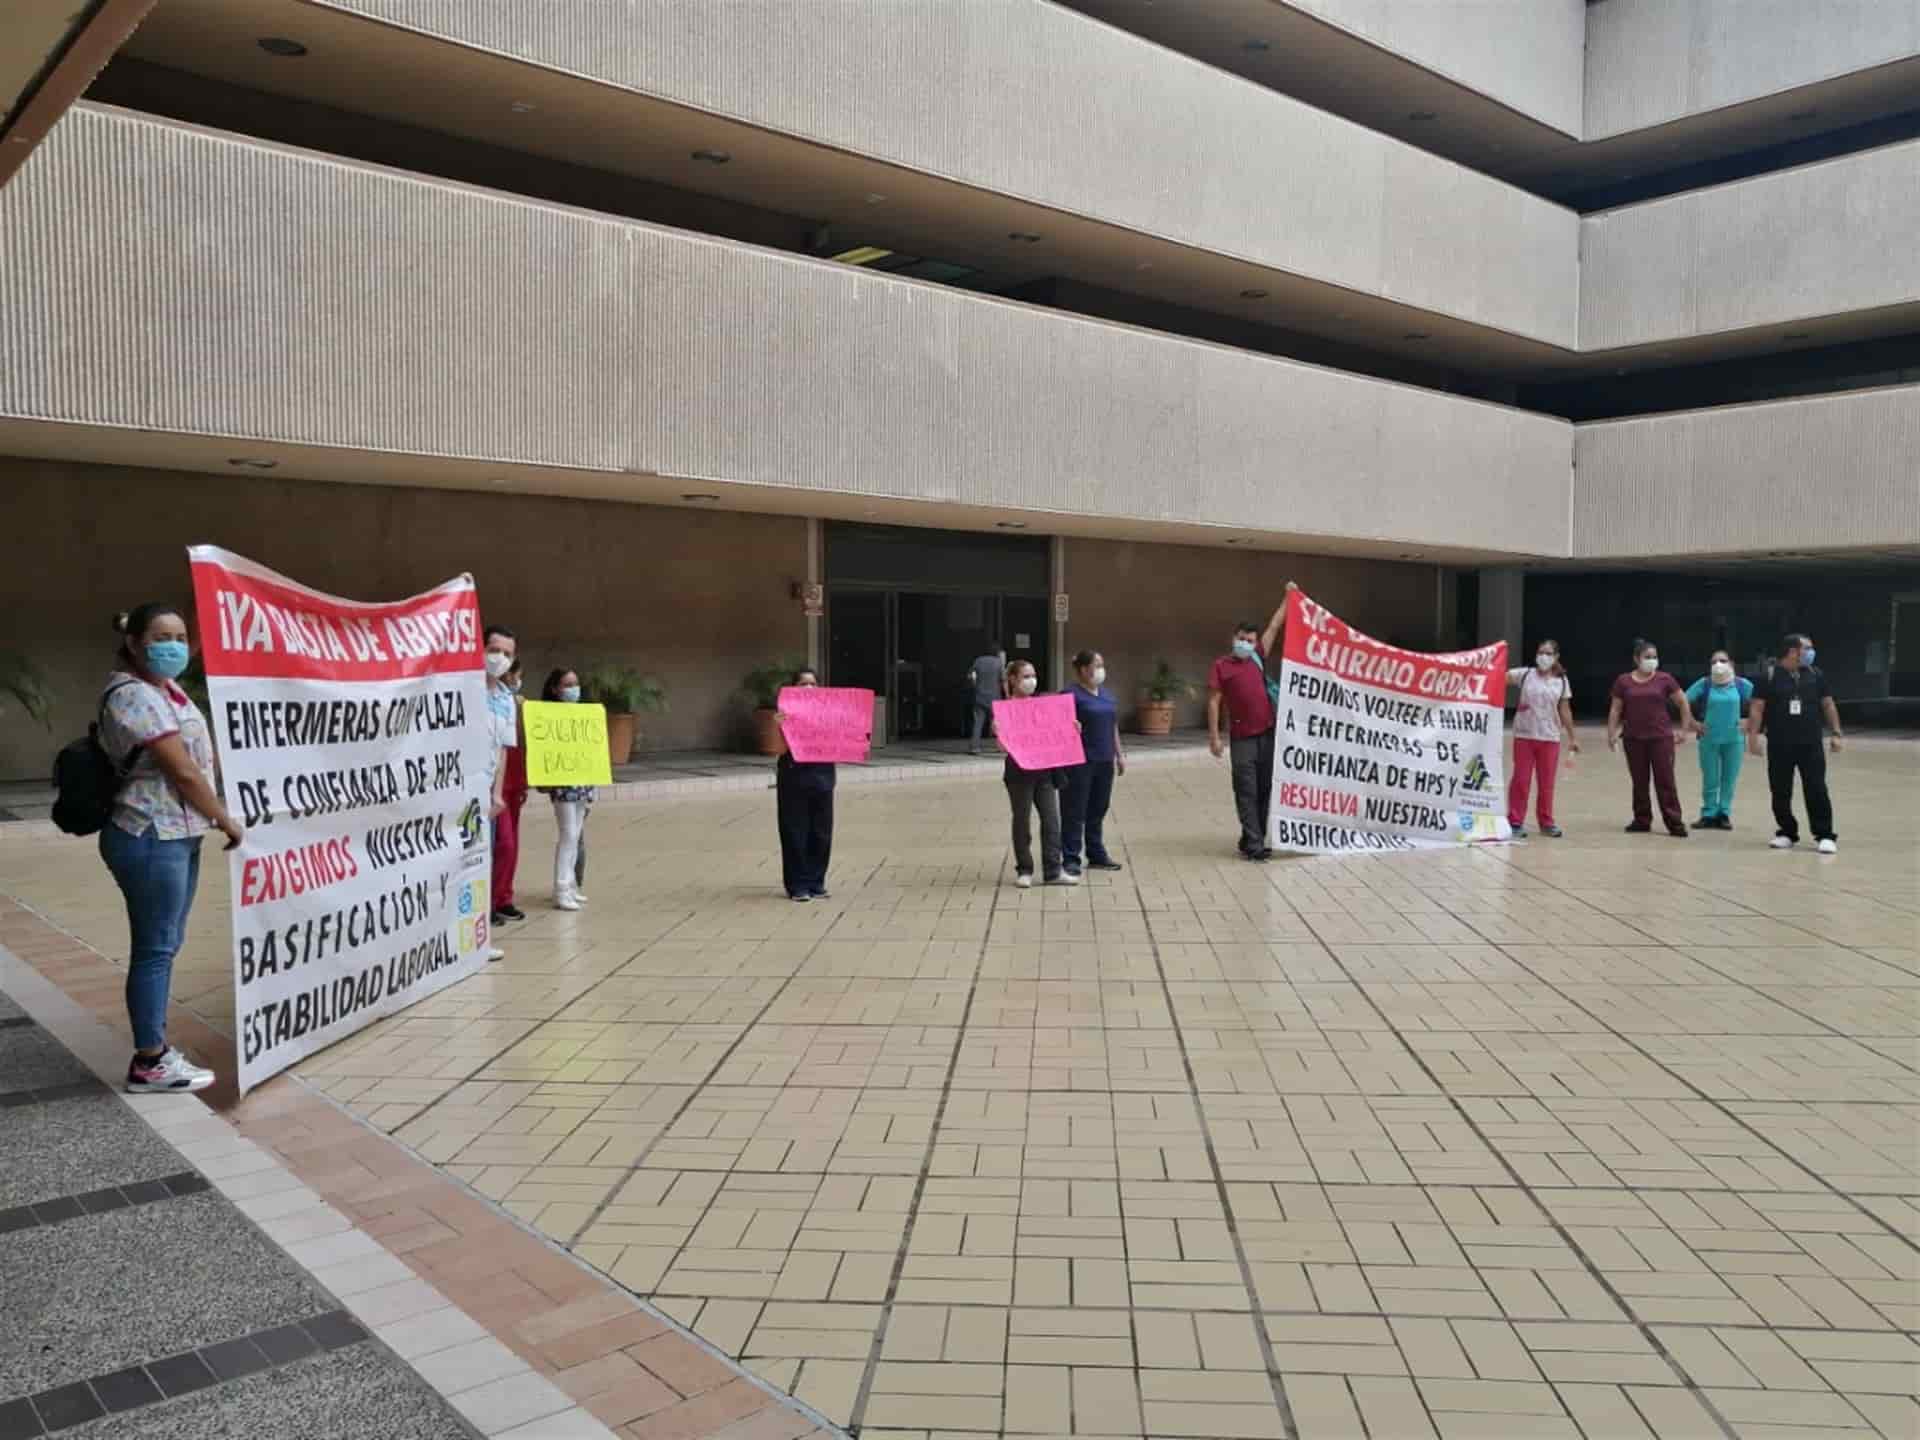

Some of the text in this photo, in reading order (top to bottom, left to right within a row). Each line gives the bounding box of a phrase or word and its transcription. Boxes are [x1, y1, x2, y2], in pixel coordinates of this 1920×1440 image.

[216, 591, 273, 653] ¡YA
[266, 604, 350, 661] BASTA
[341, 617, 388, 661] DE
[1306, 634, 1415, 688] QUIRINO
[1419, 667, 1489, 699] ORDAZ
[226, 699, 380, 750] ENFERMERAS
[413, 690, 466, 733] PLAZA
[1289, 671, 1360, 711] PEDIMOS
[1364, 694, 1424, 727] VOLTEE
[1423, 707, 1436, 729] A
[1286, 709, 1460, 763] A ENFERMERAS DE
[238, 778, 274, 828] DE
[283, 766, 400, 820] CONFIANZA
[404, 758, 428, 797] DE
[1282, 745, 1459, 799] CONFIANZA DE HPS Y
[1280, 782, 1359, 817] RESUELVA
[1365, 796, 1447, 831] NUESTRAS
[240, 814, 448, 907] EXIGIMOS NUESTRA
[240, 871, 449, 985] BASIFICACIÓN Y
[242, 964, 383, 1065] ESTABILIDAD
